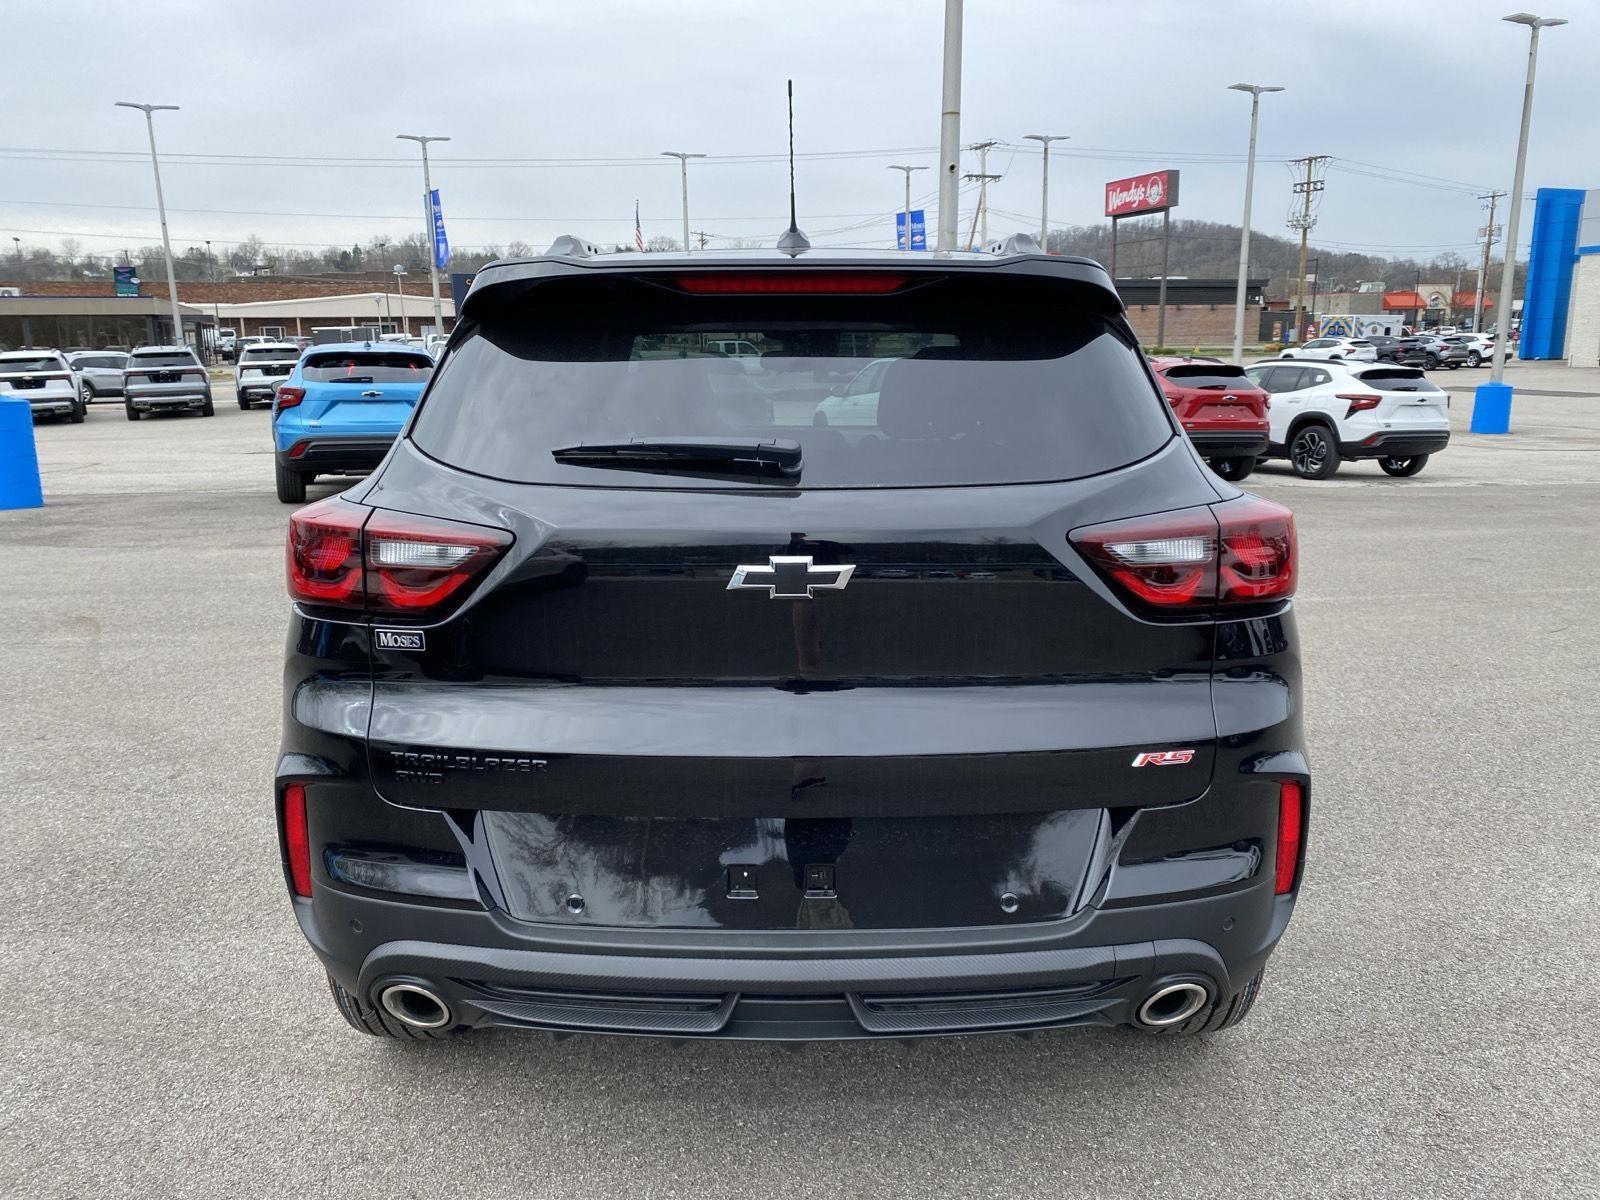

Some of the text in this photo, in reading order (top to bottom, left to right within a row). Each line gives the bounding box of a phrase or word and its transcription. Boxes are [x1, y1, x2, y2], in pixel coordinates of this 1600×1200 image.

[1108, 182, 1146, 212] Wendy's
[390, 751, 548, 774] TRAILBLAZER
[1131, 749, 1196, 767] RS
